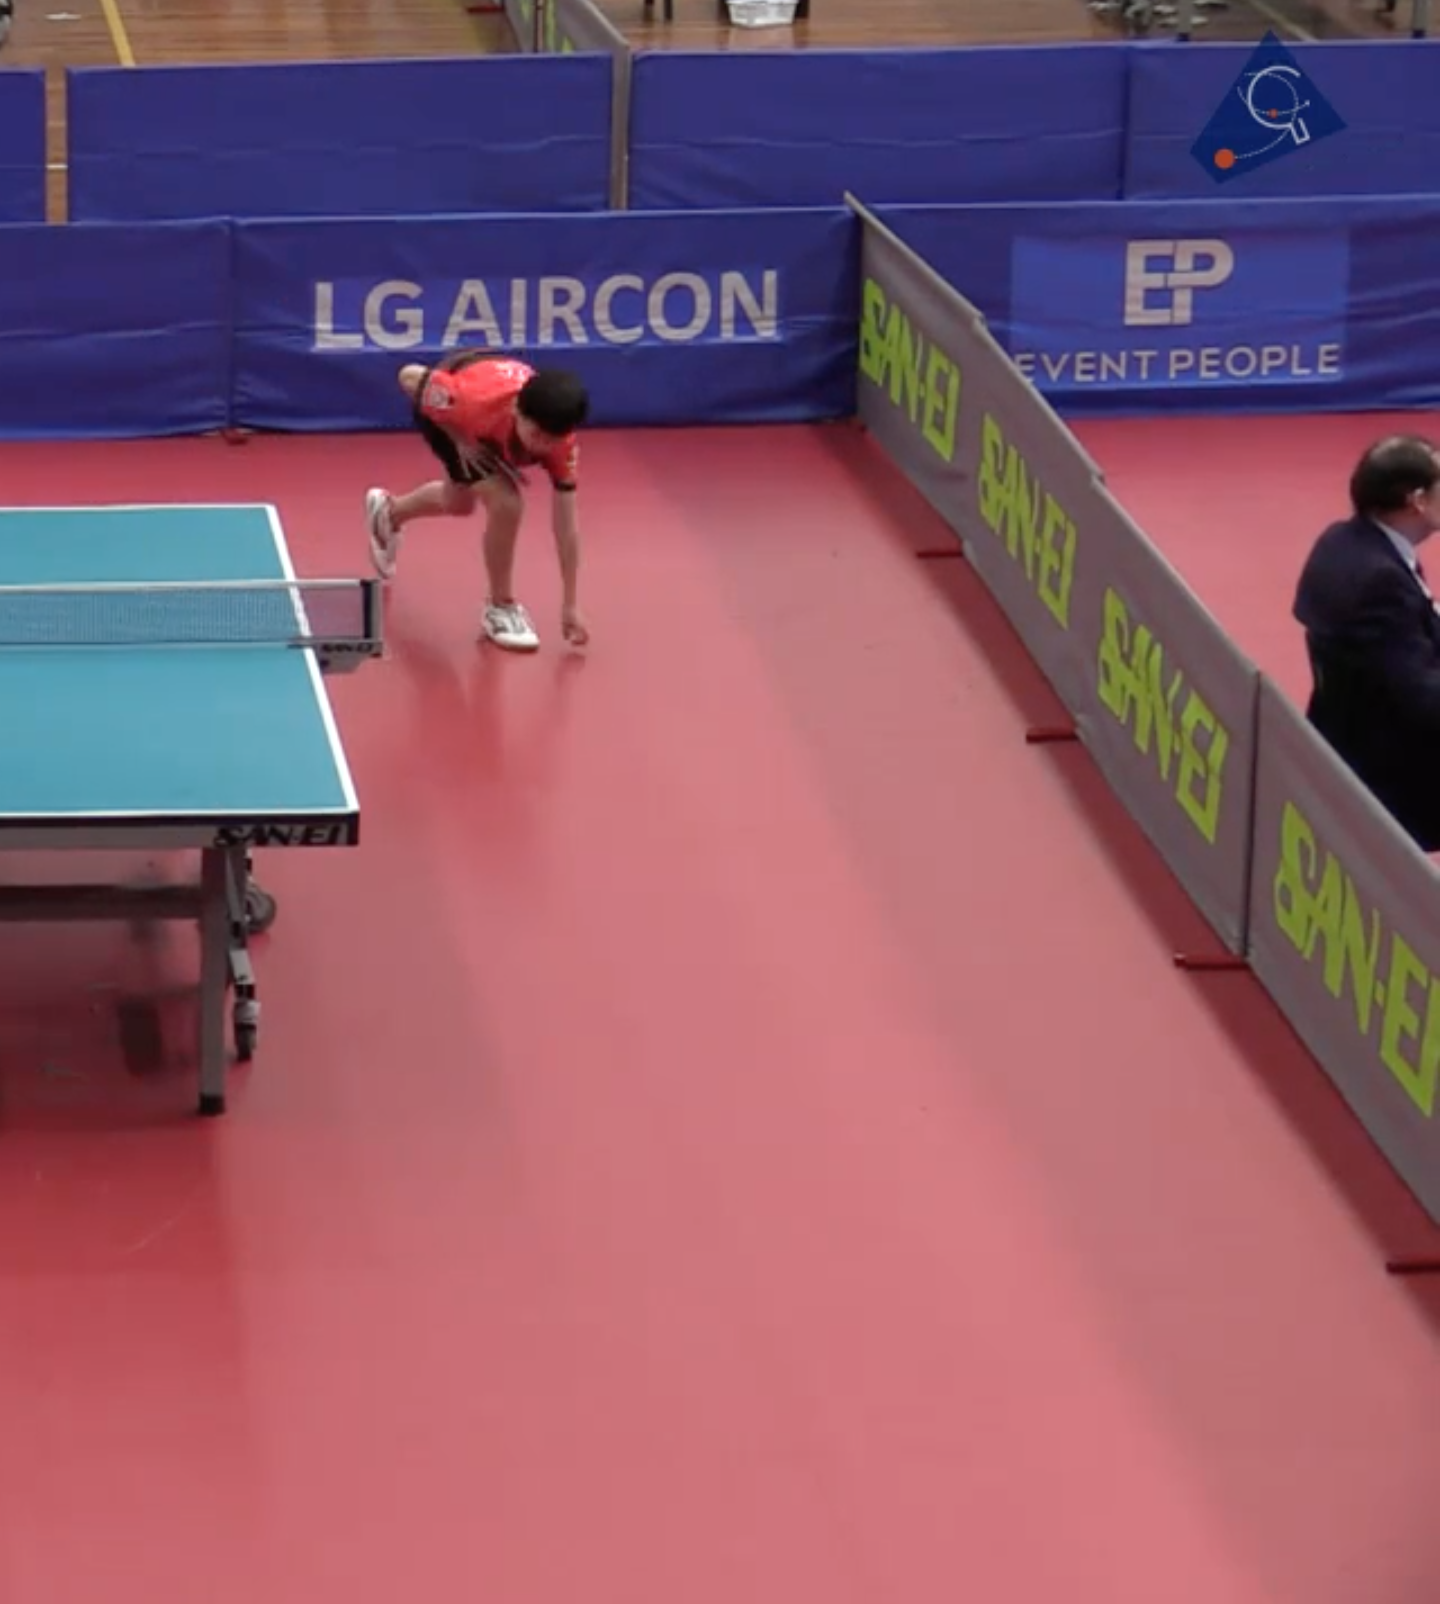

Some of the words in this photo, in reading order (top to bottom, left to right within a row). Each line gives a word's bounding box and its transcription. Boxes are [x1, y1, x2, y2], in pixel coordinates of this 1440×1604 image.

[311, 279, 427, 350] LG
[440, 269, 779, 348] AIRCON
[860, 278, 960, 462] SAN-EI
[1014, 350, 1159, 383] EVENT
[1169, 343, 1341, 380] PEOPLE
[978, 412, 1077, 630] SAN-EI
[1097, 587, 1229, 844] SAN-EI
[1273, 800, 1440, 1118] SAN-EI
